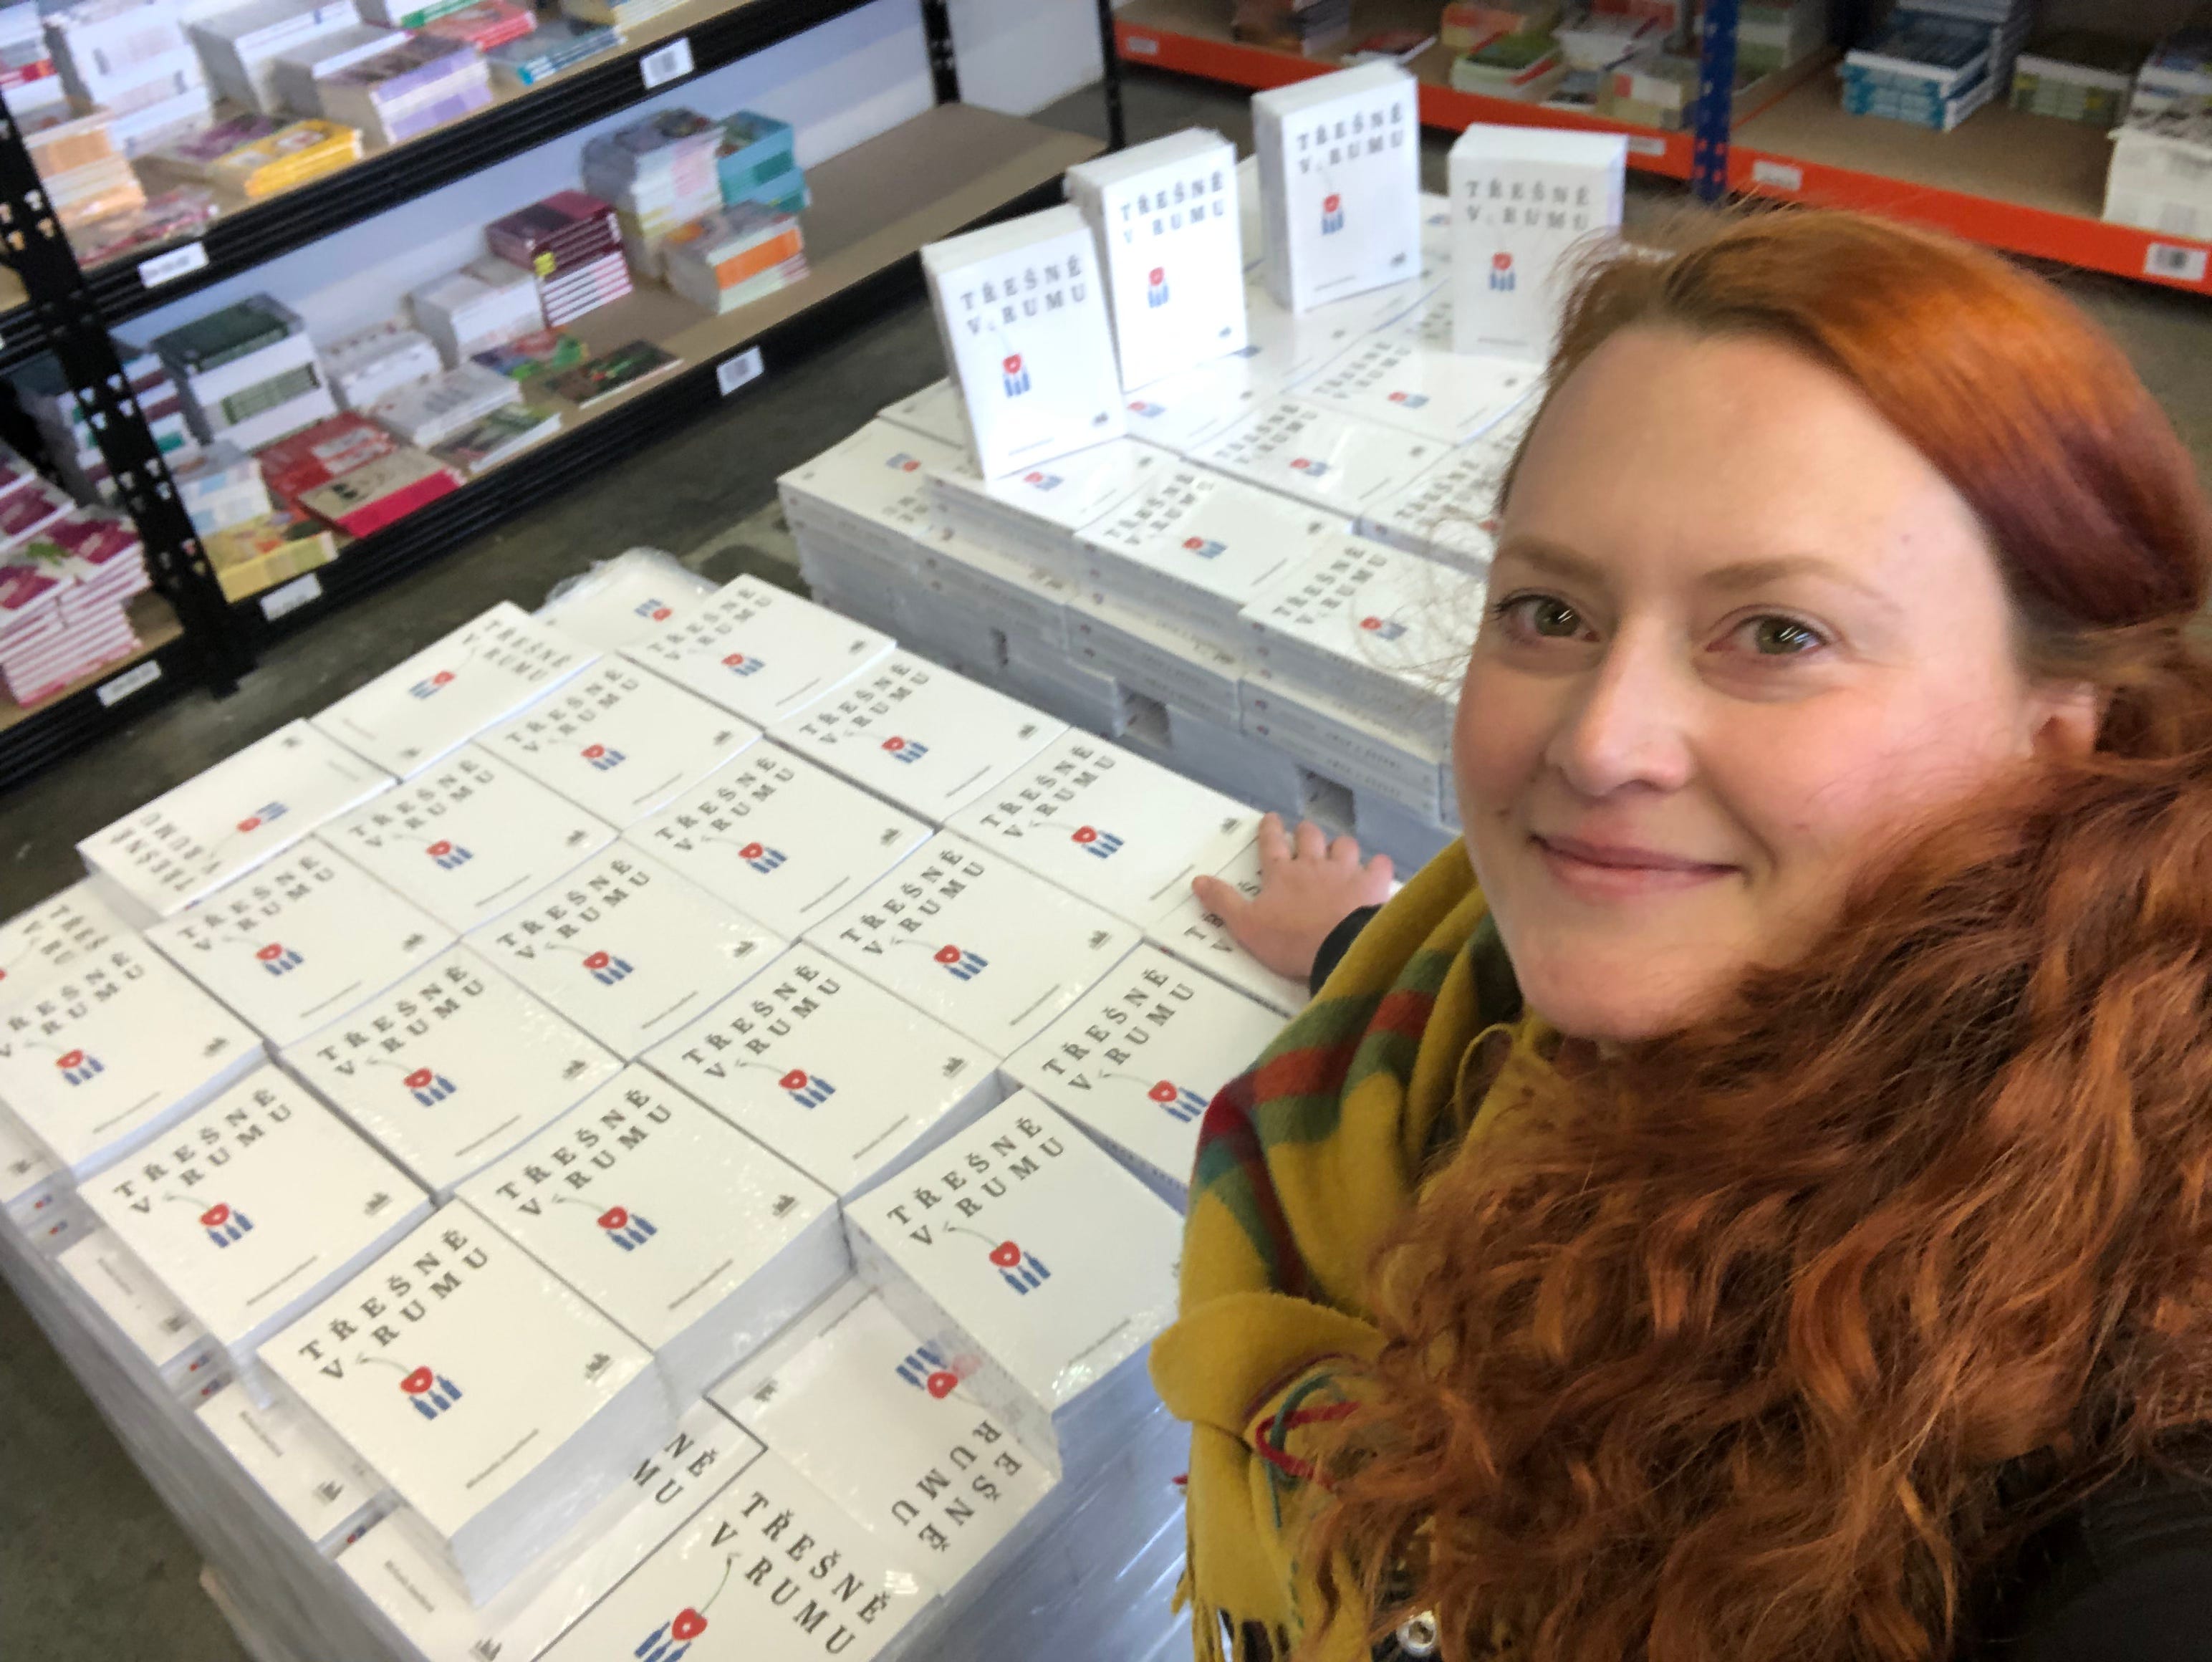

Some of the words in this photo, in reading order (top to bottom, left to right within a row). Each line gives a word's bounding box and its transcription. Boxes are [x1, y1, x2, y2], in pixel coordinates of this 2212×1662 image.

[1300, 159, 1310, 173] V
[1330, 130, 1404, 165] RUMU
[1124, 229, 1133, 244] V
[1152, 199, 1223, 236] RUMU
[1467, 206, 1478, 221] V
[1504, 208, 1588, 231] RUMU
[967, 316, 980, 334] V
[1001, 284, 1086, 325] RUMU
[674, 838, 693, 851] V
[711, 769, 794, 832] RUMU
[1003, 824, 1023, 838] V
[1036, 756, 1115, 817] RUMU
[515, 946, 536, 959] V
[557, 871, 650, 939] RUMU
[840, 849, 964, 943] TŘEŠNĚ
[862, 941, 883, 955] V
[898, 862, 985, 933] RUMU
[335, 1060, 355, 1076] V
[380, 979, 484, 1053] RUMU
[681, 964, 819, 1065] TŘEŠNĚ
[704, 1063, 726, 1079] V
[745, 979, 841, 1056] RUMU
[1042, 969, 1170, 1077] TŘEŠNĚ
[1068, 1073, 1092, 1092] V
[1104, 984, 1196, 1066] RUMU
[114, 1088, 275, 1199] TŘEŠNĚ
[130, 1198, 150, 1214] V
[179, 1104, 292, 1187] RUMU
[496, 1088, 650, 1200] TŘEŠNĚ
[517, 1197, 542, 1218] V
[564, 1104, 672, 1191] RUMU
[886, 1116, 1043, 1228] TŘEŠNĚ
[909, 1224, 933, 1246] V
[955, 1137, 1064, 1218] RUMU
[298, 1229, 468, 1362] TŘEŠNĚ
[319, 1358, 345, 1380] V
[370, 1247, 489, 1348] RUMU
[630, 1457, 684, 1506] MU
[891, 1419, 1002, 1527] RUMU
[918, 1451, 1022, 1552] EŠNĚ
[711, 1521, 739, 1548] V
[744, 1555, 856, 1656] RUMU
[740, 1492, 890, 1625] TŘEŠNĚ
